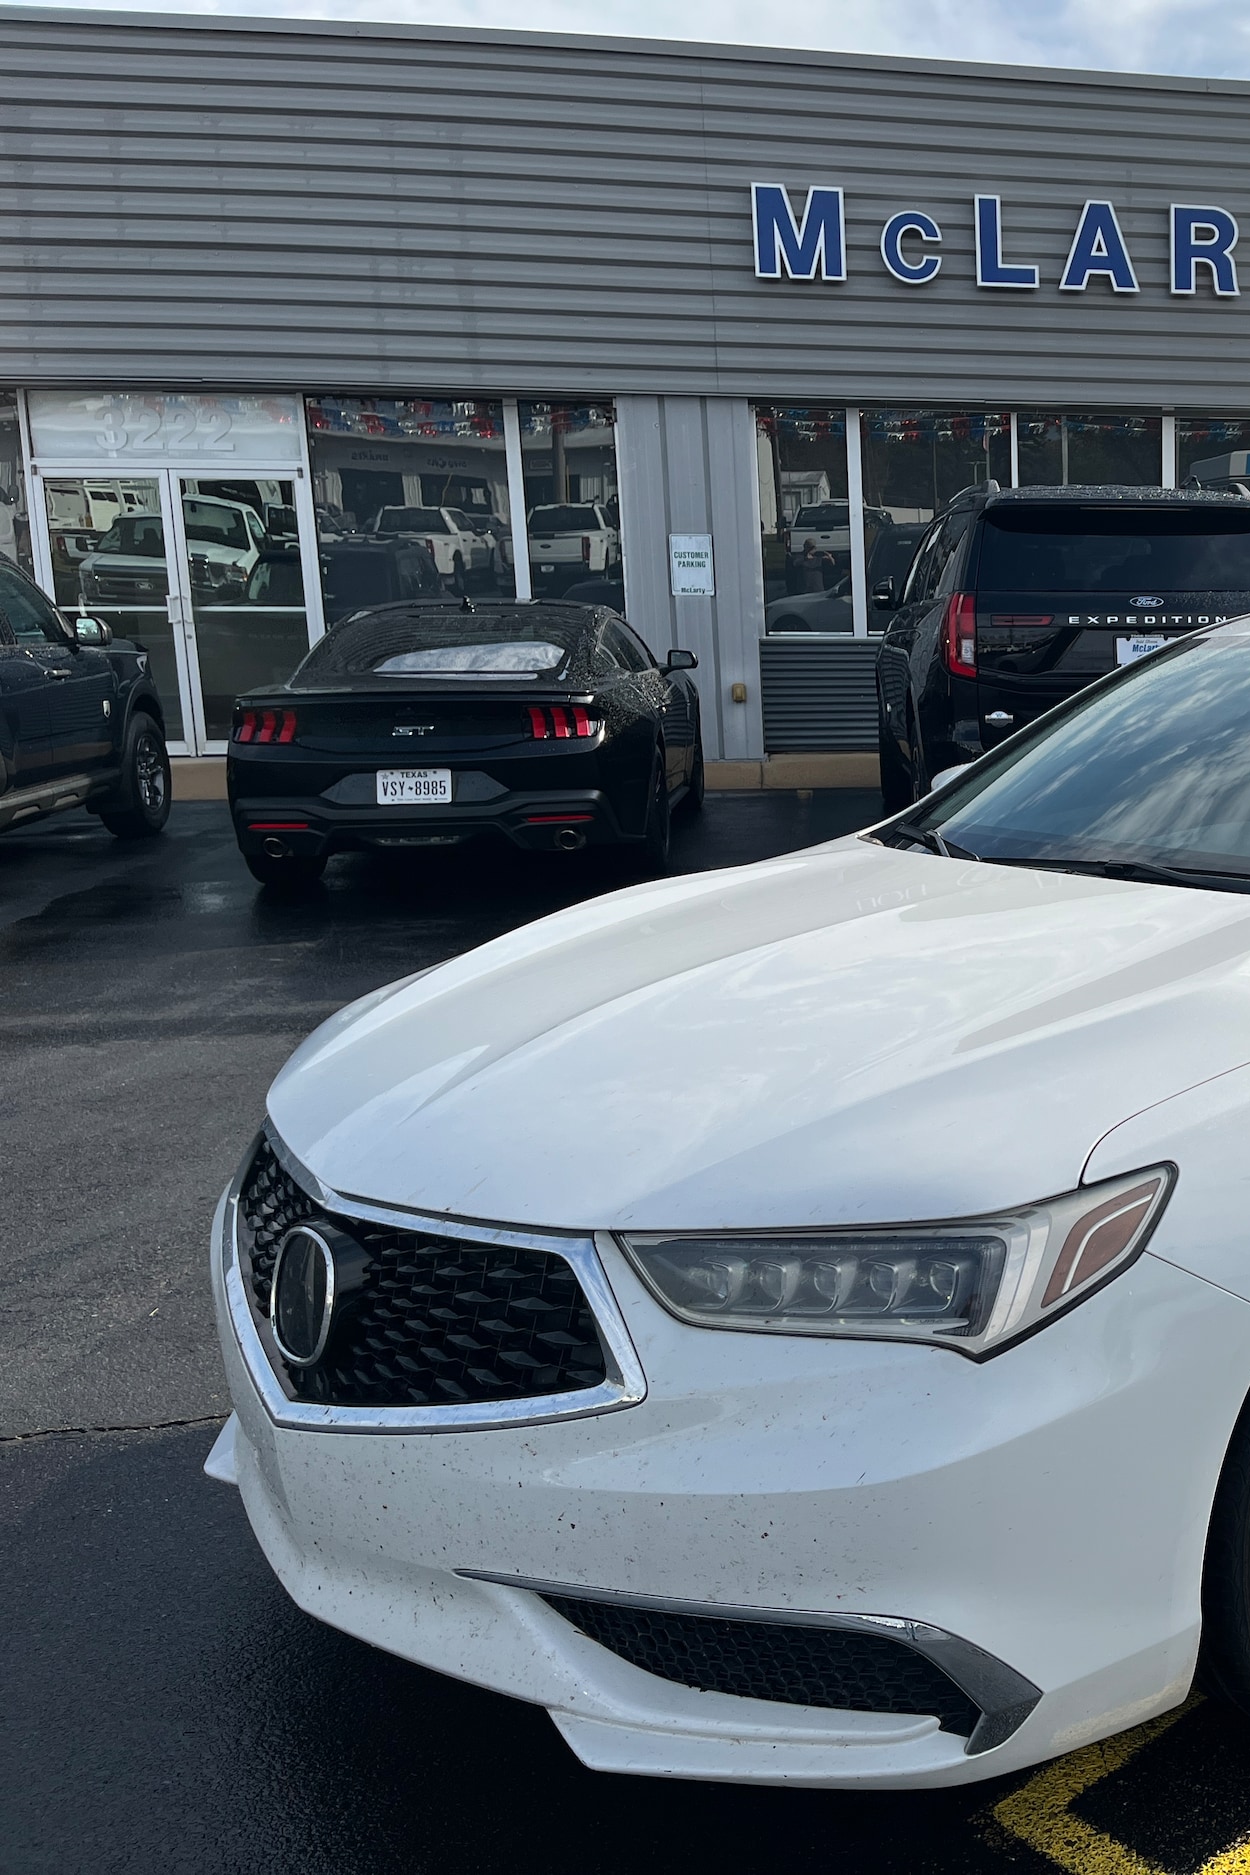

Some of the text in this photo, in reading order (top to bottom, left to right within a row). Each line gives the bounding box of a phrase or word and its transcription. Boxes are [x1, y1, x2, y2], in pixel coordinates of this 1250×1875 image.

[95, 406, 236, 452] 3222
[673, 551, 709, 559] CUSTOMER
[677, 560, 706, 568] PARKING
[681, 587, 706, 595] McLarty
[1068, 616, 1226, 624] EXPEDITION
[400, 771, 428, 779] TEXAS
